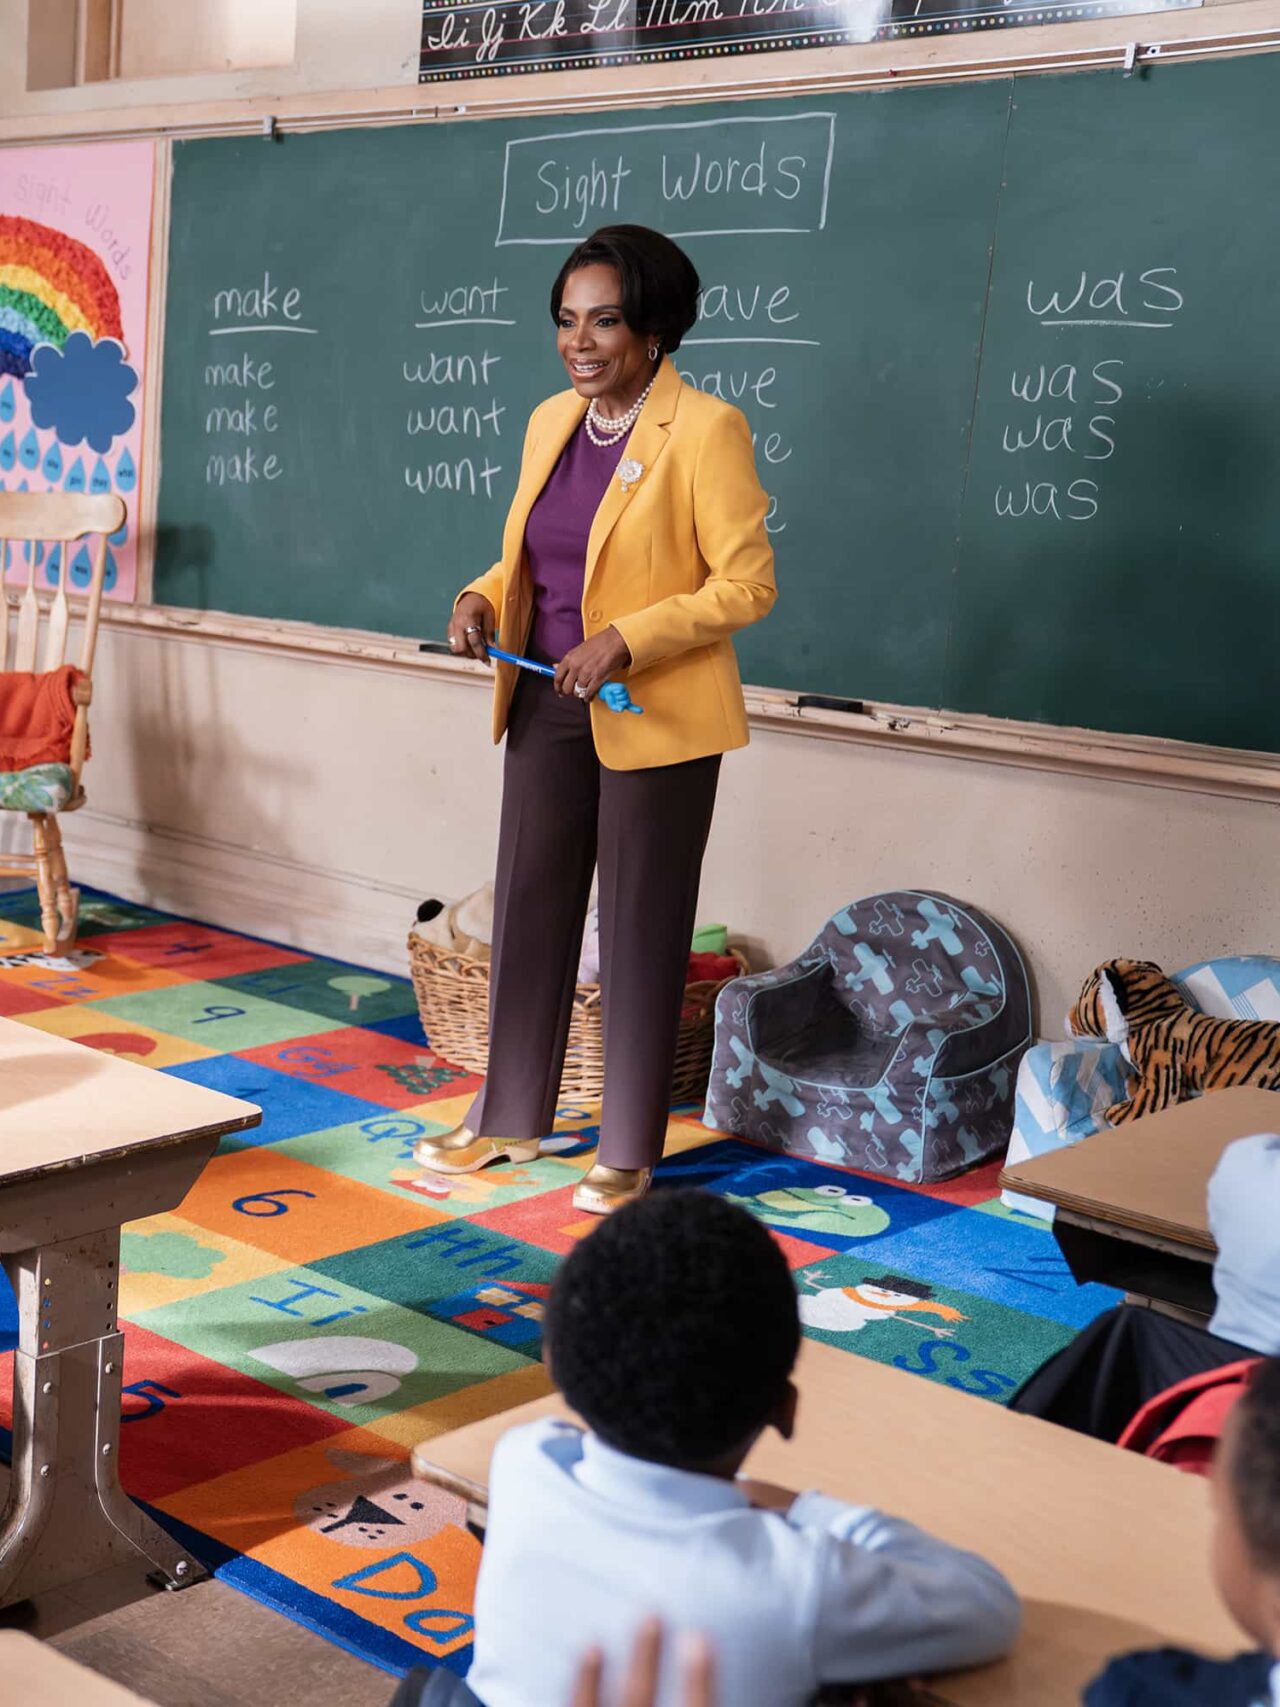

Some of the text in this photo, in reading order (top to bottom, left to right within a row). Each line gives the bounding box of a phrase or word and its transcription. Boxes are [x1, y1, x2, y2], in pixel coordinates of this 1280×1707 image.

[519, 0, 568, 40] Kk
[535, 141, 806, 229] Sight Words
[213, 271, 302, 320] make
[419, 277, 509, 317] want
[698, 284, 800, 323] ave
[1026, 267, 1183, 316] was
[204, 352, 276, 389] make
[402, 349, 502, 386] want
[1010, 360, 1124, 404] was
[204, 400, 279, 436] make
[406, 397, 507, 438] want
[1002, 414, 1116, 460] was
[205, 447, 283, 486] make
[403, 456, 502, 499] want
[994, 478, 1099, 521] was
[231, 1189, 317, 1217] 6
[404, 1227, 524, 1277] Hh
[249, 1278, 369, 1327] Ii
[892, 1339, 1018, 1396] Ss
[120, 1379, 182, 1423] 5
